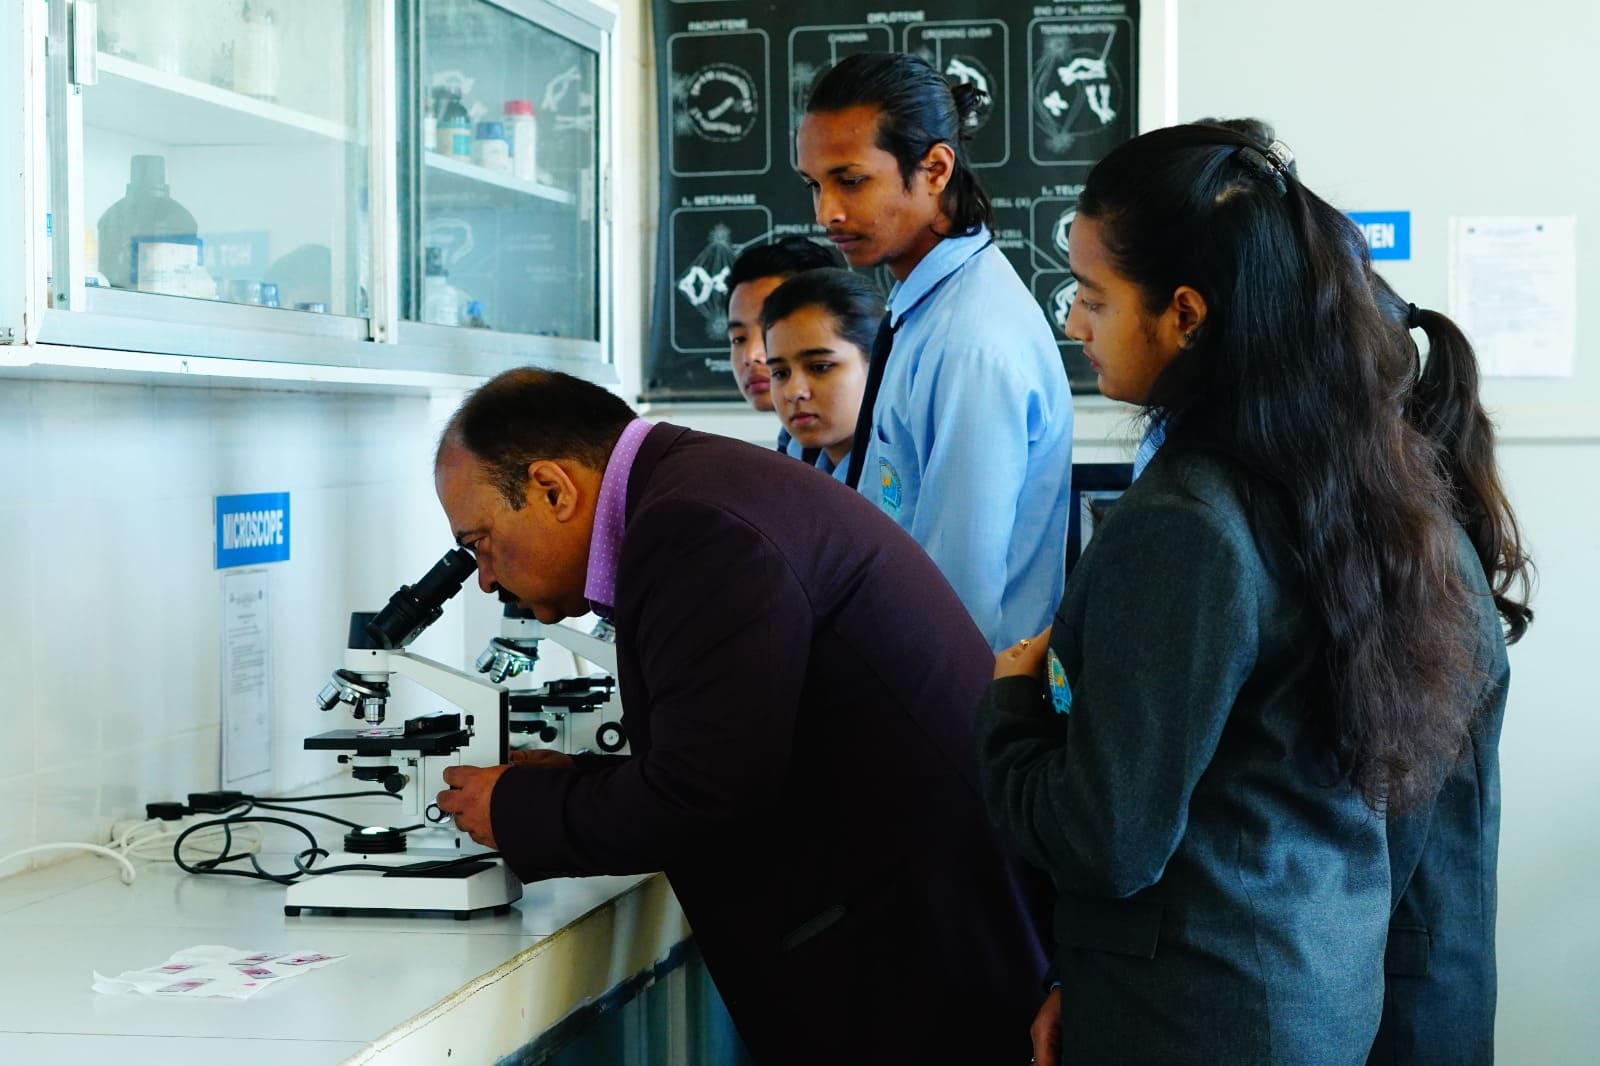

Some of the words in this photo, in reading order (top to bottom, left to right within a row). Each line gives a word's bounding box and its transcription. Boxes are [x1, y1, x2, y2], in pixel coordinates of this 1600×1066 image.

[687, 19, 748, 31] PACHYTENE
[694, 193, 756, 206] METAPHASE
[1358, 223, 1395, 249] VEN
[223, 509, 283, 550] MICROSCOPE
